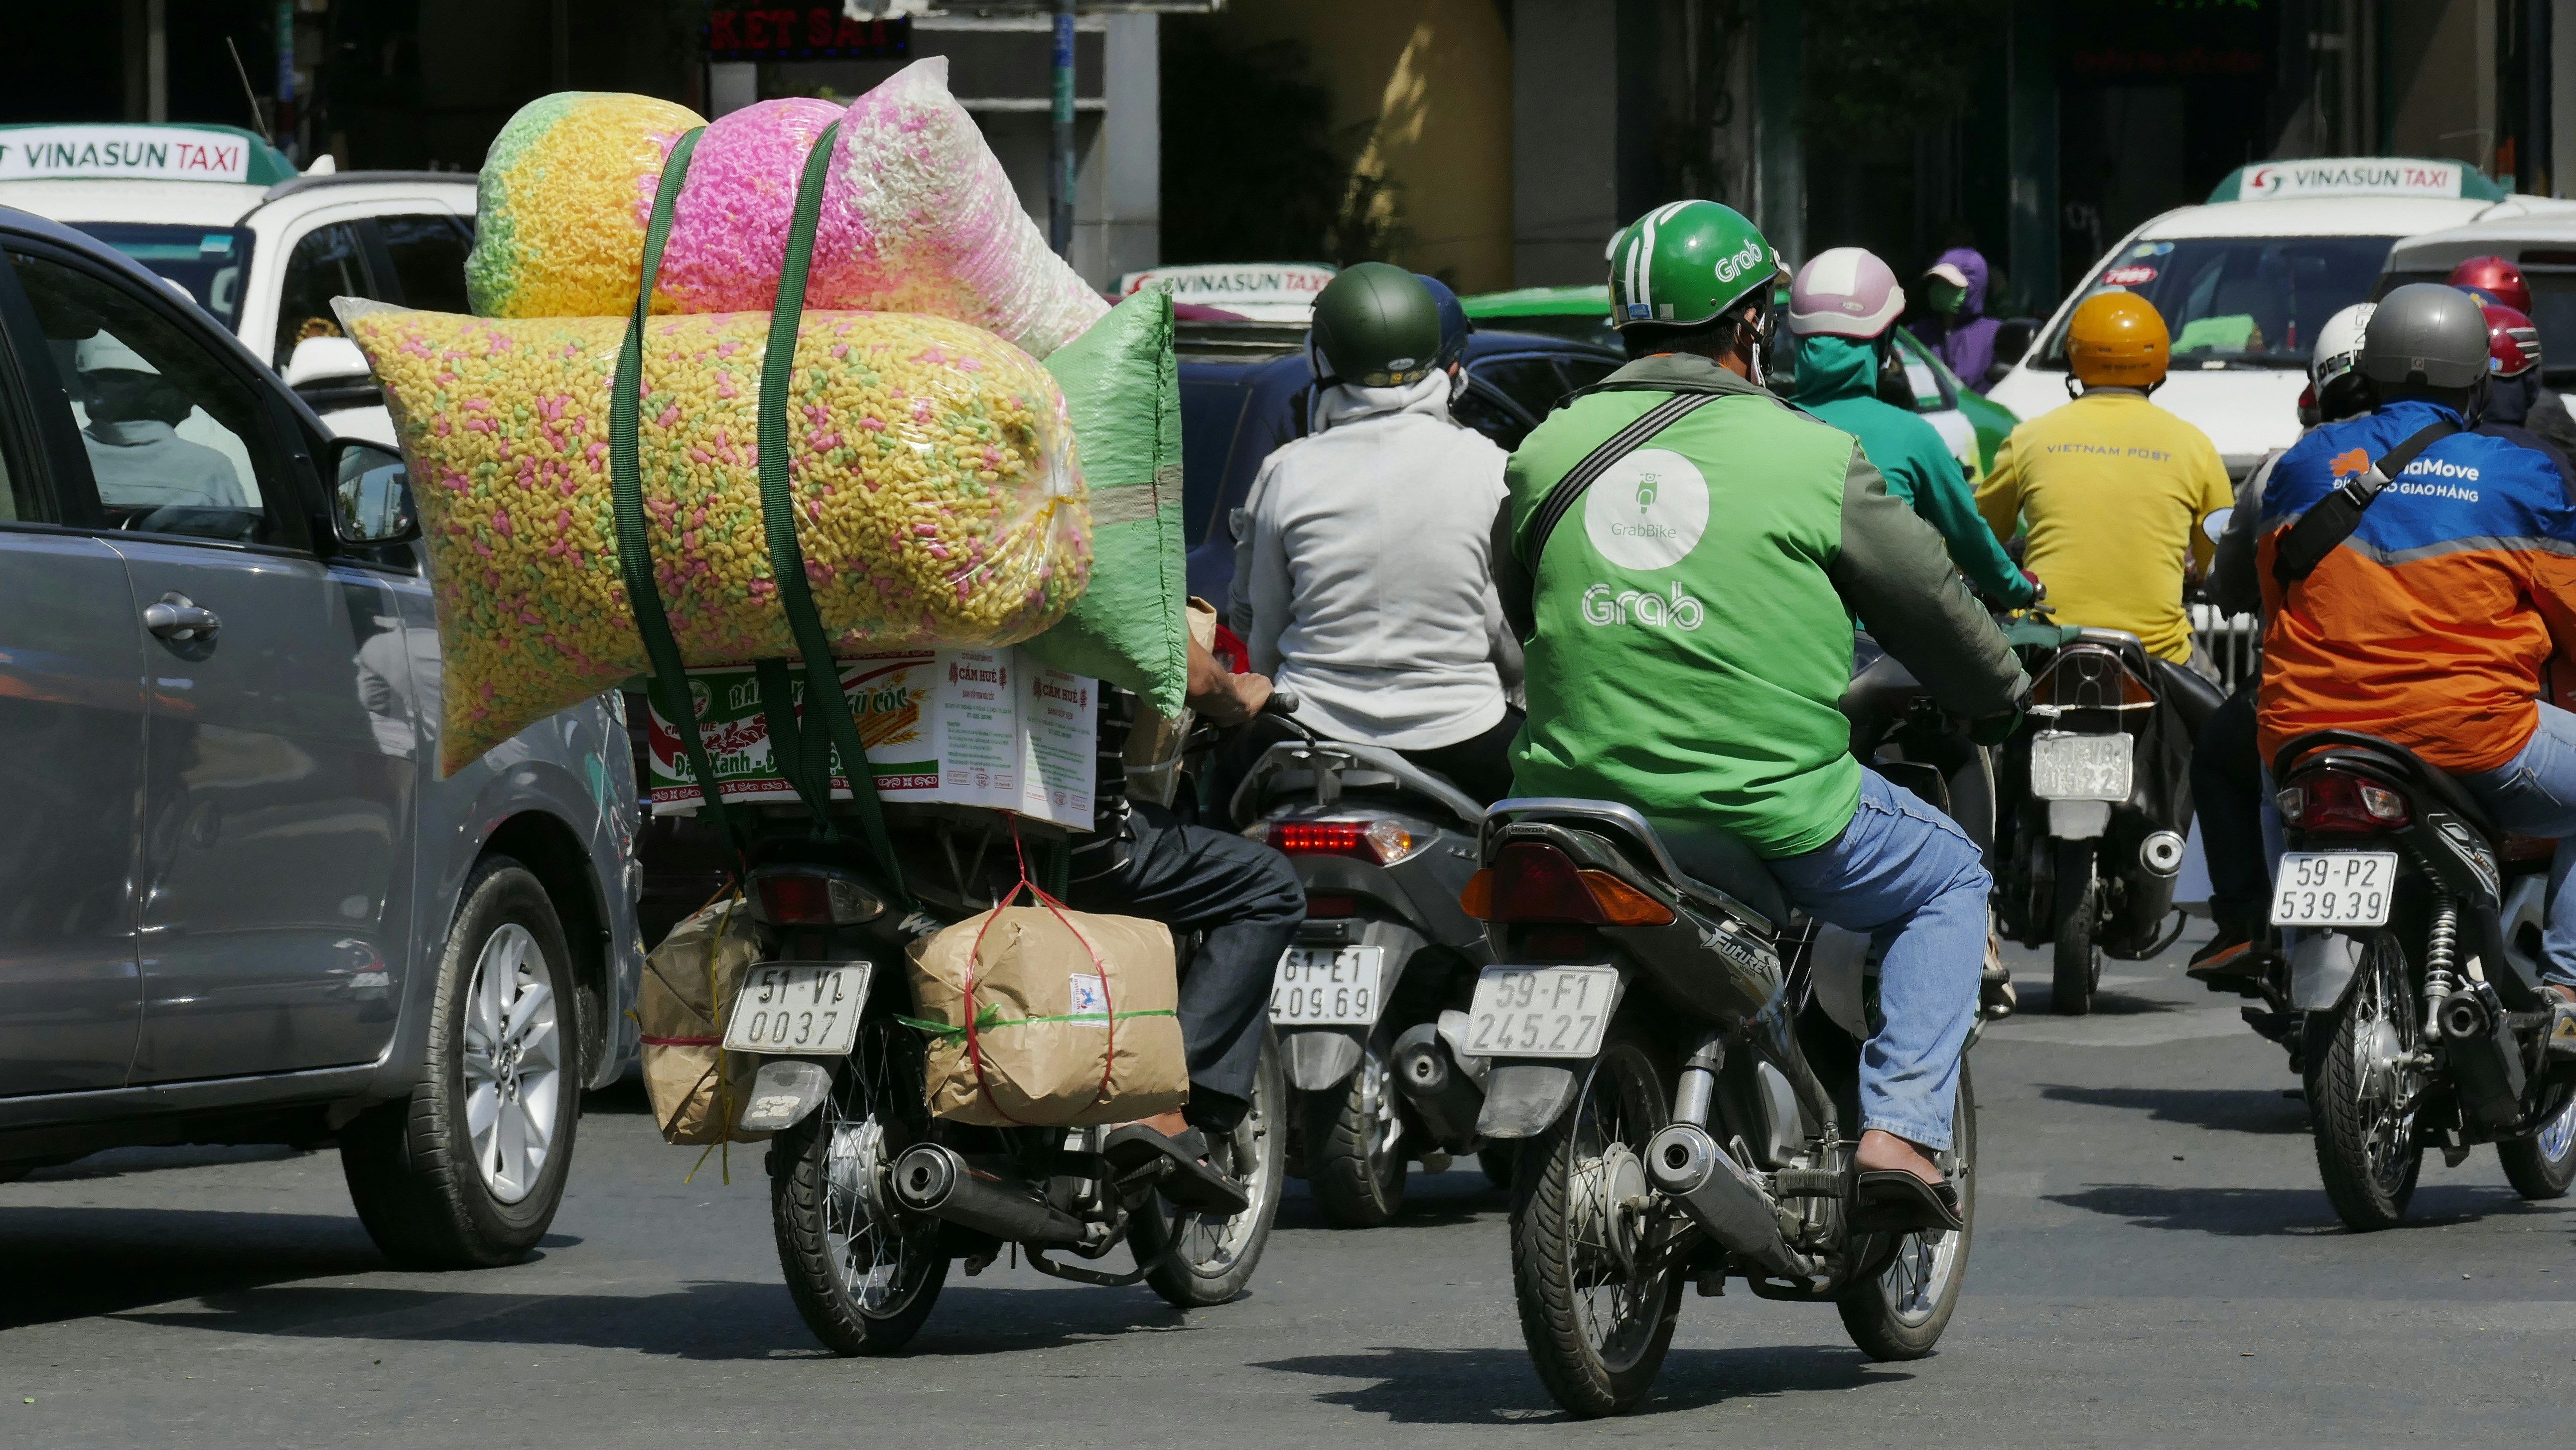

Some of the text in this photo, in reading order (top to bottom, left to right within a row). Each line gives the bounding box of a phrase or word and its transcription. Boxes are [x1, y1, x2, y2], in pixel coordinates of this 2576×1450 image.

[25, 142, 239, 172] VINASUN TAXI
[2295, 166, 2447, 188] VINASUN TAXI
[1715, 239, 1763, 282] Grab
[1176, 273, 1280, 292] VINASUN
[2047, 444, 2171, 462] VIETNAM POST
[2404, 458, 2479, 481] aMove
[2400, 482, 2436, 496] GIAO
[1611, 523, 1676, 538] GrabBike
[1582, 581, 1704, 632] Grab
[708, 750, 751, 774] Xanh
[2297, 859, 2378, 887] 59-P2
[2281, 891, 2382, 920] 539.39
[1284, 950, 1361, 982] 61-E1
[1739, 964, 1756, 978] HONDA
[1269, 986, 1369, 1018] 409.69
[1495, 972, 1591, 1010] 59-F1
[749, 1011, 838, 1046] 0037
[1473, 1013, 1597, 1051] 245.27
